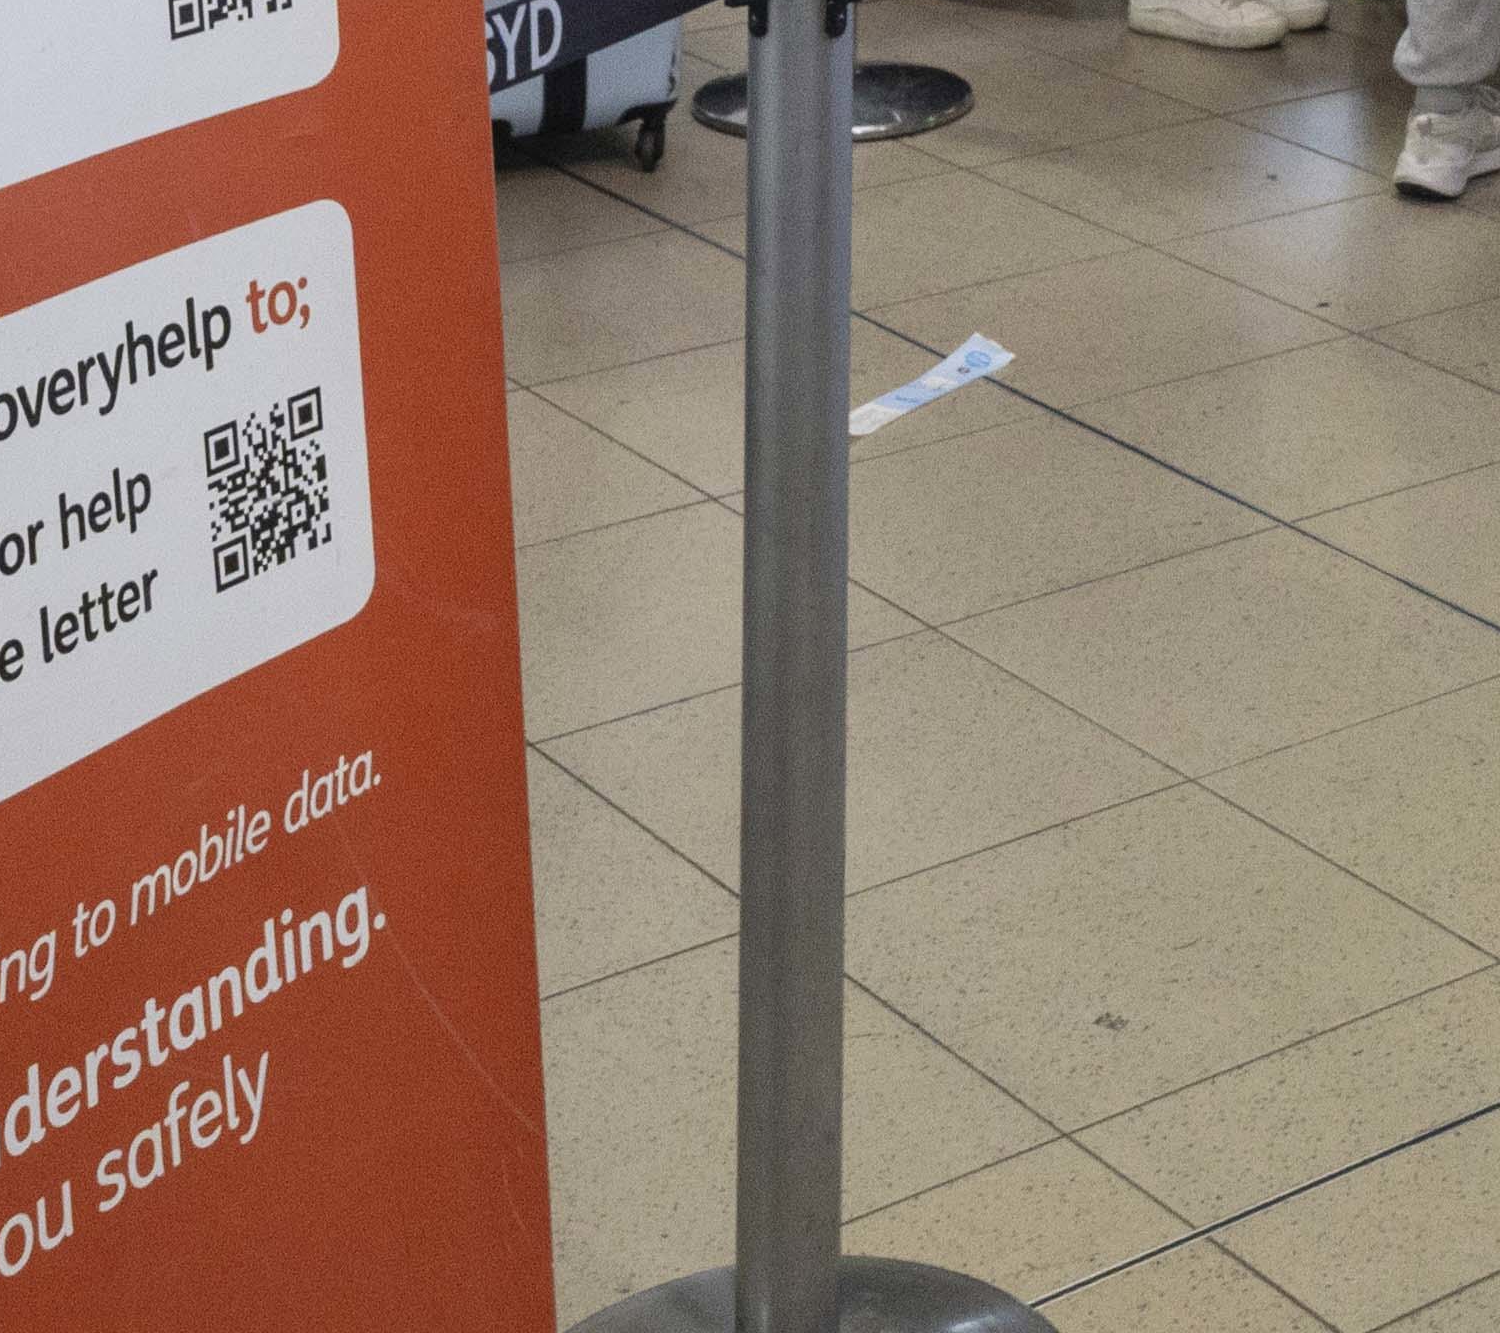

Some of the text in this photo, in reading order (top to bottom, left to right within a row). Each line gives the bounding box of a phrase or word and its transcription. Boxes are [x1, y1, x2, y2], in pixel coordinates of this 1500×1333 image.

[245, 268, 312, 335] to;
[56, 467, 152, 561] help
[39, 564, 159, 661] letter
[72, 893, 118, 951] to
[127, 816, 271, 929] mobile
[283, 744, 383, 835] data.
[95, 1052, 270, 1223] safely
